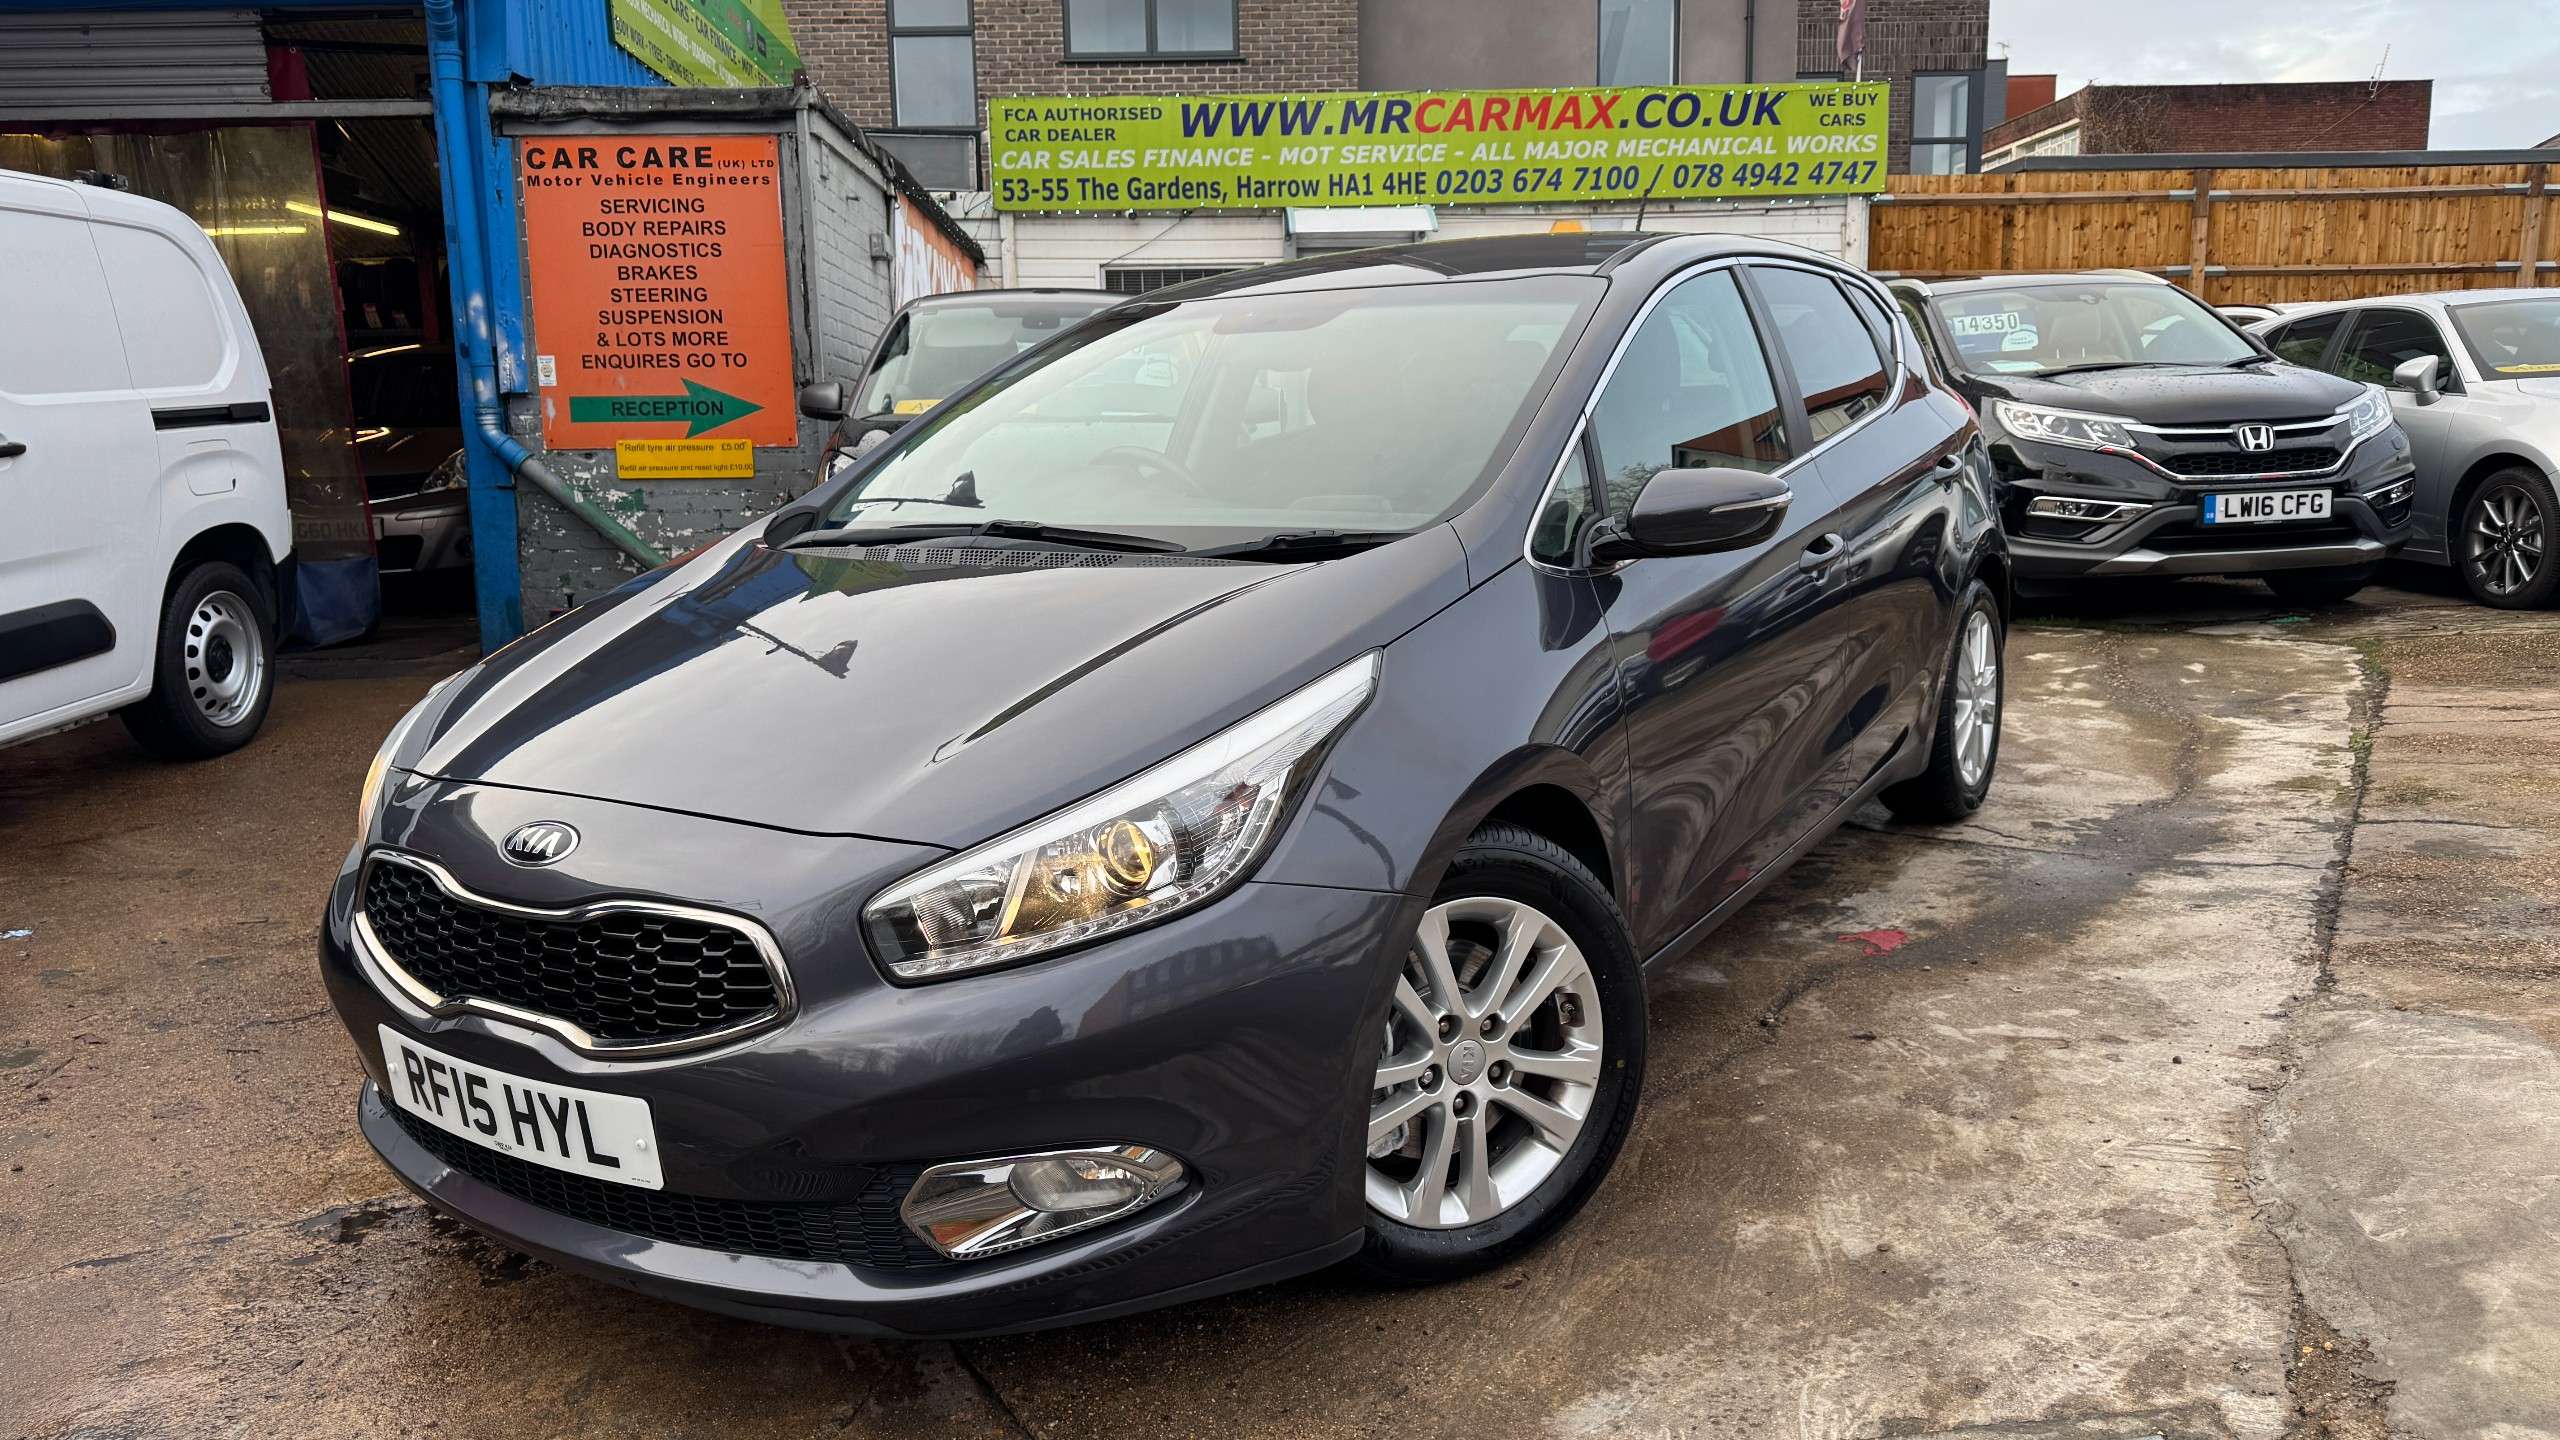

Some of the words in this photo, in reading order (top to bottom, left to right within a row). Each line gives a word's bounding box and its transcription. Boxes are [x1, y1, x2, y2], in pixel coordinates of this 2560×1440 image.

[1809, 93, 1836, 107] WE
[1842, 92, 1879, 106] BUY
[1004, 108, 1038, 122] FCA
[1044, 107, 1162, 122] AUTHORISED
[1181, 91, 1788, 138] WWW.MRCARMAX.CO.UK
[1819, 113, 1866, 127] CARS
[1005, 129, 1041, 142] CAR
[1048, 128, 1116, 142] DEALER
[526, 147, 599, 170] CAR
[616, 146, 713, 169] CARE
[717, 159, 745, 170] (UK)
[751, 159, 775, 168] LTD
[1001, 150, 1050, 170] CAR
[1058, 149, 1135, 169] SALES
[1143, 148, 1254, 168] FINANCE
[1279, 145, 1334, 166] MOT
[1340, 143, 1447, 164] SERVICE
[1471, 142, 1515, 162] ALL
[1524, 139, 1608, 160] MAJOR
[1616, 136, 1777, 158] MECHANICAL
[1787, 134, 1878, 154] WORKS
[527, 174, 582, 187] Motor
[591, 174, 663, 186] Vehicle
[673, 173, 770, 188] Engineers
[1002, 178, 1069, 202] 53-55
[1077, 177, 1119, 201] The
[1127, 176, 1228, 204] Gardens,
[1237, 175, 1320, 199] Harrow
[1329, 172, 1373, 196] HA1
[1383, 171, 1427, 195] 4HE
[1436, 169, 1503, 194] 0203
[1512, 167, 1563, 192] 674
[1572, 164, 1640, 191] 7100
[1673, 163, 1724, 189] 078
[1732, 162, 1800, 188] 4942
[1808, 160, 1877, 186] 4747
[600, 198, 705, 214] SERVICING
[582, 221, 636, 237] BODY
[643, 220, 726, 236] REPAIRS
[590, 243, 722, 259] DIAGNOSTICS
[618, 265, 698, 281] BRAKES
[610, 288, 708, 303] STEERING
[598, 309, 723, 325] SUSPENSION
[1957, 313, 2018, 332] 14350
[597, 332, 609, 347] &
[616, 331, 666, 347] LOTS
[672, 331, 728, 346] MORE
[582, 353, 680, 369] ENQUIRES
[687, 353, 716, 368] GO
[721, 353, 747, 368] TO
[611, 401, 724, 417] RECEPTION
[678, 444, 714, 453] pressure
[2224, 496, 2274, 518] LW16
[2281, 494, 2323, 515] CFG
[507, 826, 562, 857] KIA
[401, 1045, 497, 1137] RF15
[503, 1083, 620, 1169] HYL
